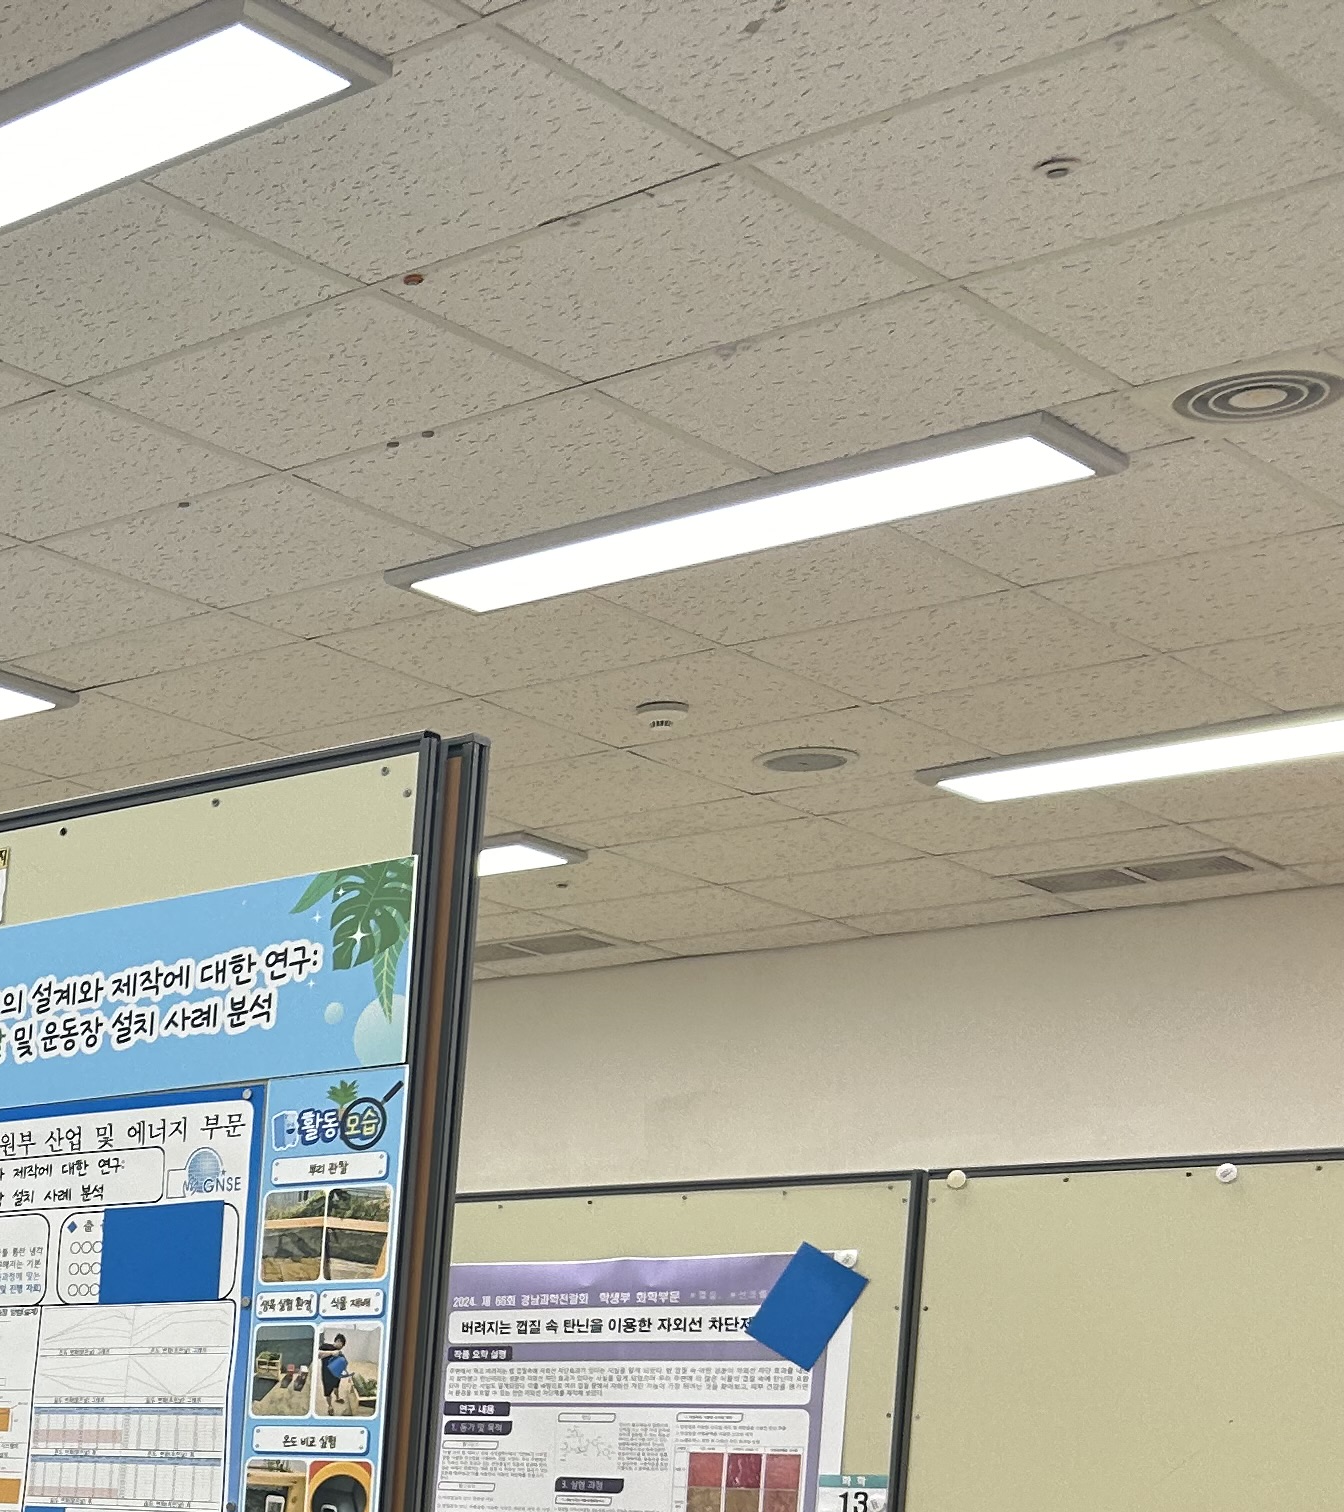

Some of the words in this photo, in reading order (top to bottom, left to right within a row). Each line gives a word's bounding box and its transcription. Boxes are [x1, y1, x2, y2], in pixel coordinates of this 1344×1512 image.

[32, 978, 103, 1011] 설계와
[112, 965, 189, 999] 제작에
[201, 953, 256, 987] 대한
[265, 946, 318, 982] 연구:
[14, 1025, 34, 1058] 및
[41, 1017, 103, 1052] 운동장
[112, 1010, 155, 1044] 설치
[163, 1002, 218, 1032] 사례
[227, 992, 273, 1027] 분석
[44, 1125, 83, 1152] 산업
[95, 1123, 115, 1149] 및
[127, 1116, 188, 1144] 에너지
[200, 1113, 247, 1141] 부문
[301, 1109, 340, 1141] 활동
[343, 1108, 381, 1138] 모습
[13, 1161, 53, 1180] 제작에
[61, 1159, 90, 1176] 대한
[12, 1188, 35, 1207] 설치
[43, 1186, 73, 1203] 사례
[80, 1183, 105, 1202] 분석
[203, 1177, 242, 1193] GNSE
[520, 1292, 589, 1306] 경남과학전람회
[599, 1291, 631, 1305] 학생부
[636, 1290, 680, 1304] 화학부문
[461, 1319, 512, 1336] 버려지는
[515, 1319, 542, 1335] 껍질
[545, 1319, 559, 1334] 속
[563, 1317, 603, 1334] 탄닌을
[608, 1316, 653, 1333] 이용한
[656, 1316, 703, 1333] 자외선
